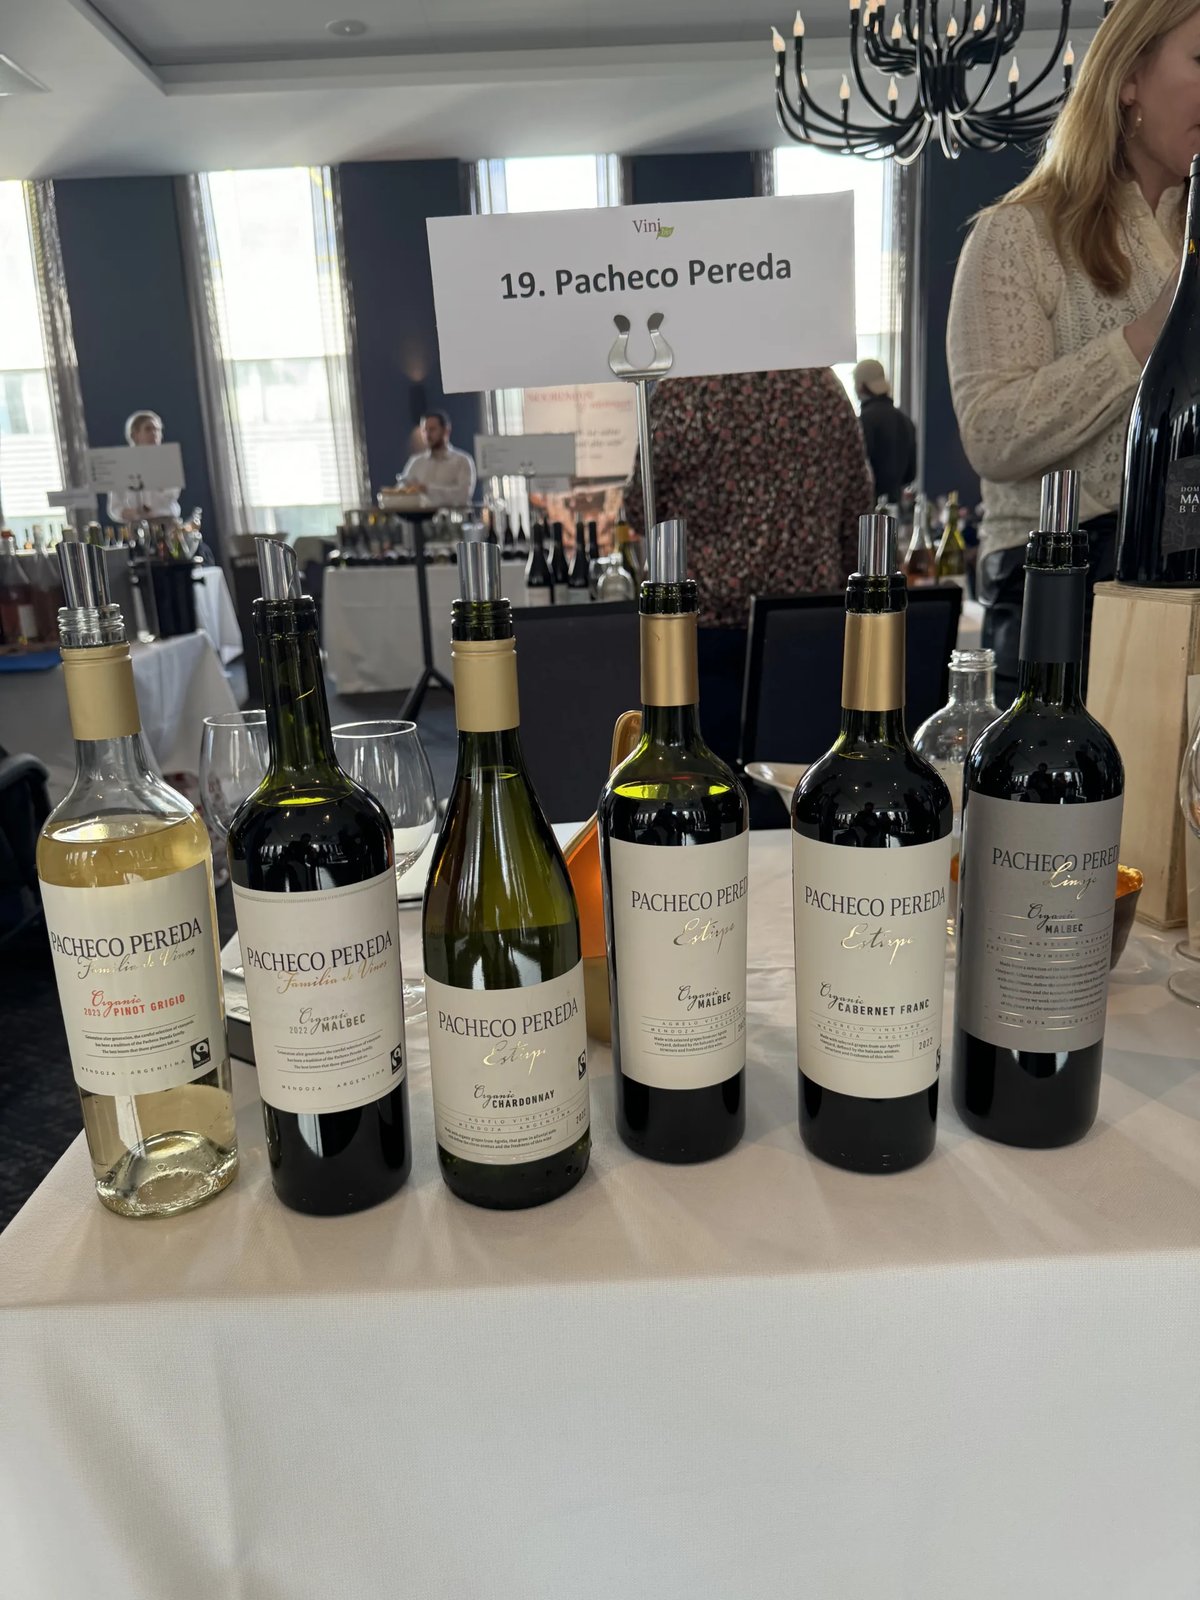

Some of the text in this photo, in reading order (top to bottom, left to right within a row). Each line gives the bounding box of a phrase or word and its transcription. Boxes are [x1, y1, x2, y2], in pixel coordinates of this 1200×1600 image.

[632, 217, 661, 233] Vini
[501, 252, 791, 299] 19. Pacheco Pereda
[1180, 494, 1200, 504] MA
[992, 848, 1077, 872] PACHECO
[631, 890, 713, 912] PACHECO
[805, 886, 946, 917] PACHECO PEREDA
[1027, 903, 1075, 930] Organic
[1045, 923, 1083, 934] MALBEC
[51, 917, 202, 958] PACHECO PEREDA
[247, 930, 392, 972] PACHECO PEREDA
[91, 990, 142, 1018] Organic
[113, 1005, 145, 1016] PINOT
[150, 994, 185, 1011] GRIGIO
[678, 985, 720, 1011] Organic
[698, 991, 731, 1009] MALBEC
[820, 982, 863, 1009] Organic
[838, 999, 929, 1016] CABERNET FRANC
[289, 1013, 366, 1034] 2022 MALBEC
[299, 1007, 348, 1035] Organic
[438, 997, 578, 1038] PACHECO PEREDA
[474, 1084, 515, 1109] Organic
[492, 1089, 555, 1108] CHARDONNAY
